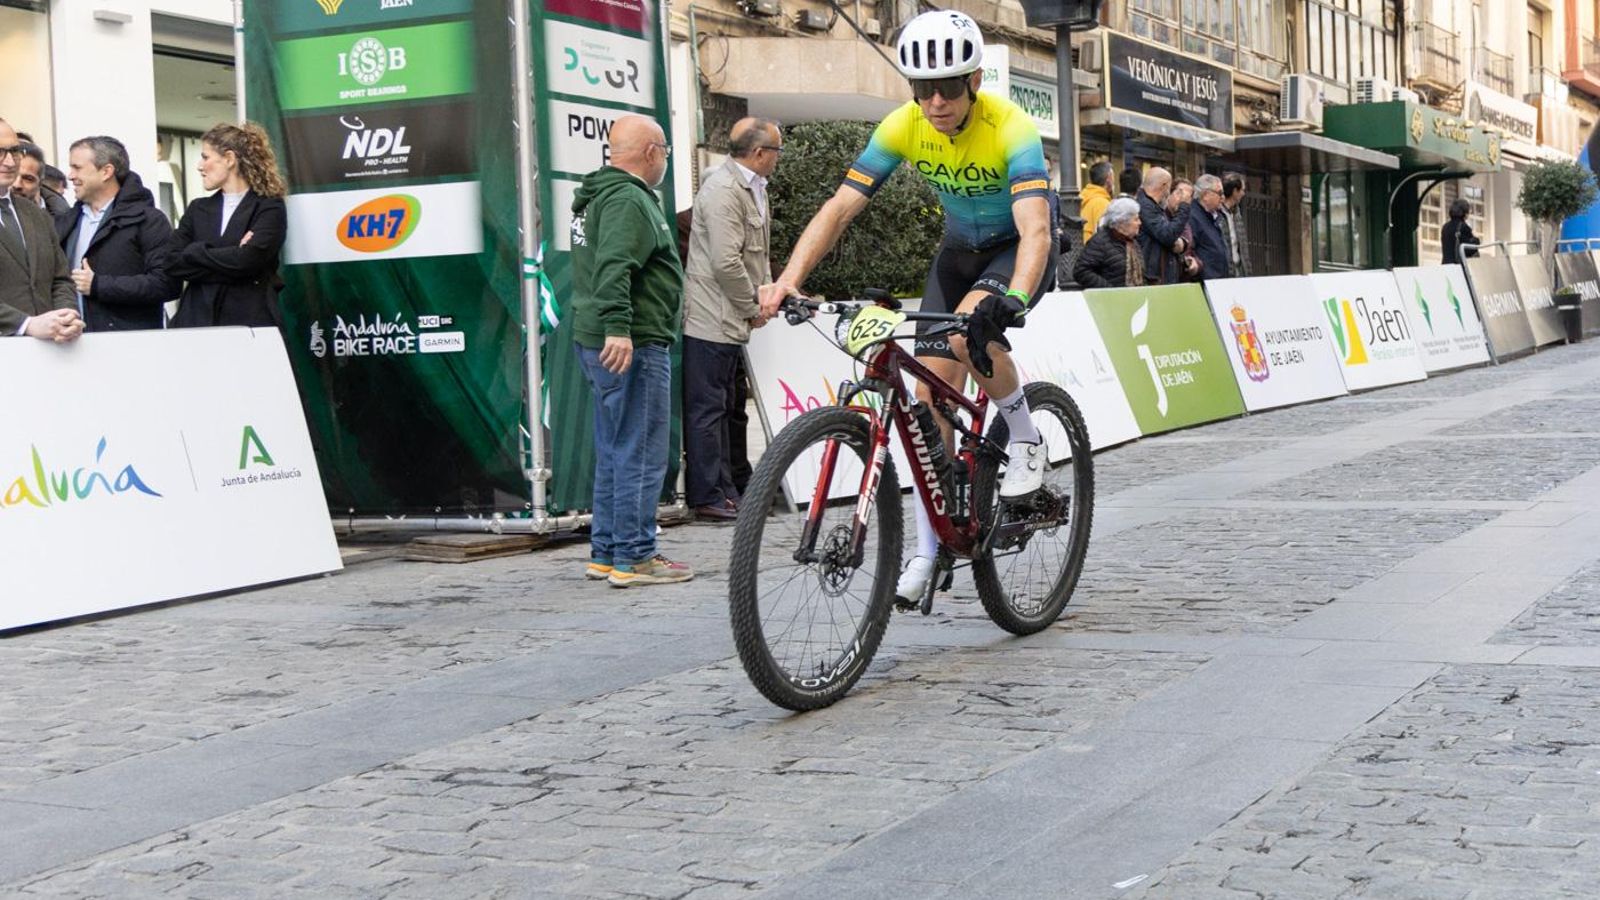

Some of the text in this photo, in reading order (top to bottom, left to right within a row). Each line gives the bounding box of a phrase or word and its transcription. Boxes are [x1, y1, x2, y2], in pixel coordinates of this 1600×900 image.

[1127, 56, 1218, 101] VERÓNICA Y JESÚS
[340, 90, 366, 99] SPORT
[568, 114, 615, 141] POW
[342, 126, 411, 159] NDL
[916, 160, 1001, 182] CAYÓN
[347, 208, 405, 239] KH-7
[332, 312, 415, 338] Andalucía
[851, 318, 893, 342] 625
[1355, 296, 1411, 346] Jaén
[334, 335, 417, 357] BIKE RACE
[424, 338, 461, 348] GARMIN
[1264, 325, 1323, 345] AYUNTAMIENTO
[1155, 348, 1203, 369] DIPUTACIÓN
[1270, 351, 1283, 366] DE
[1161, 373, 1174, 388] DE
[0, 435, 163, 508] alucía
[221, 467, 302, 487] Junta de Andalucía
[789, 639, 861, 687] roval
